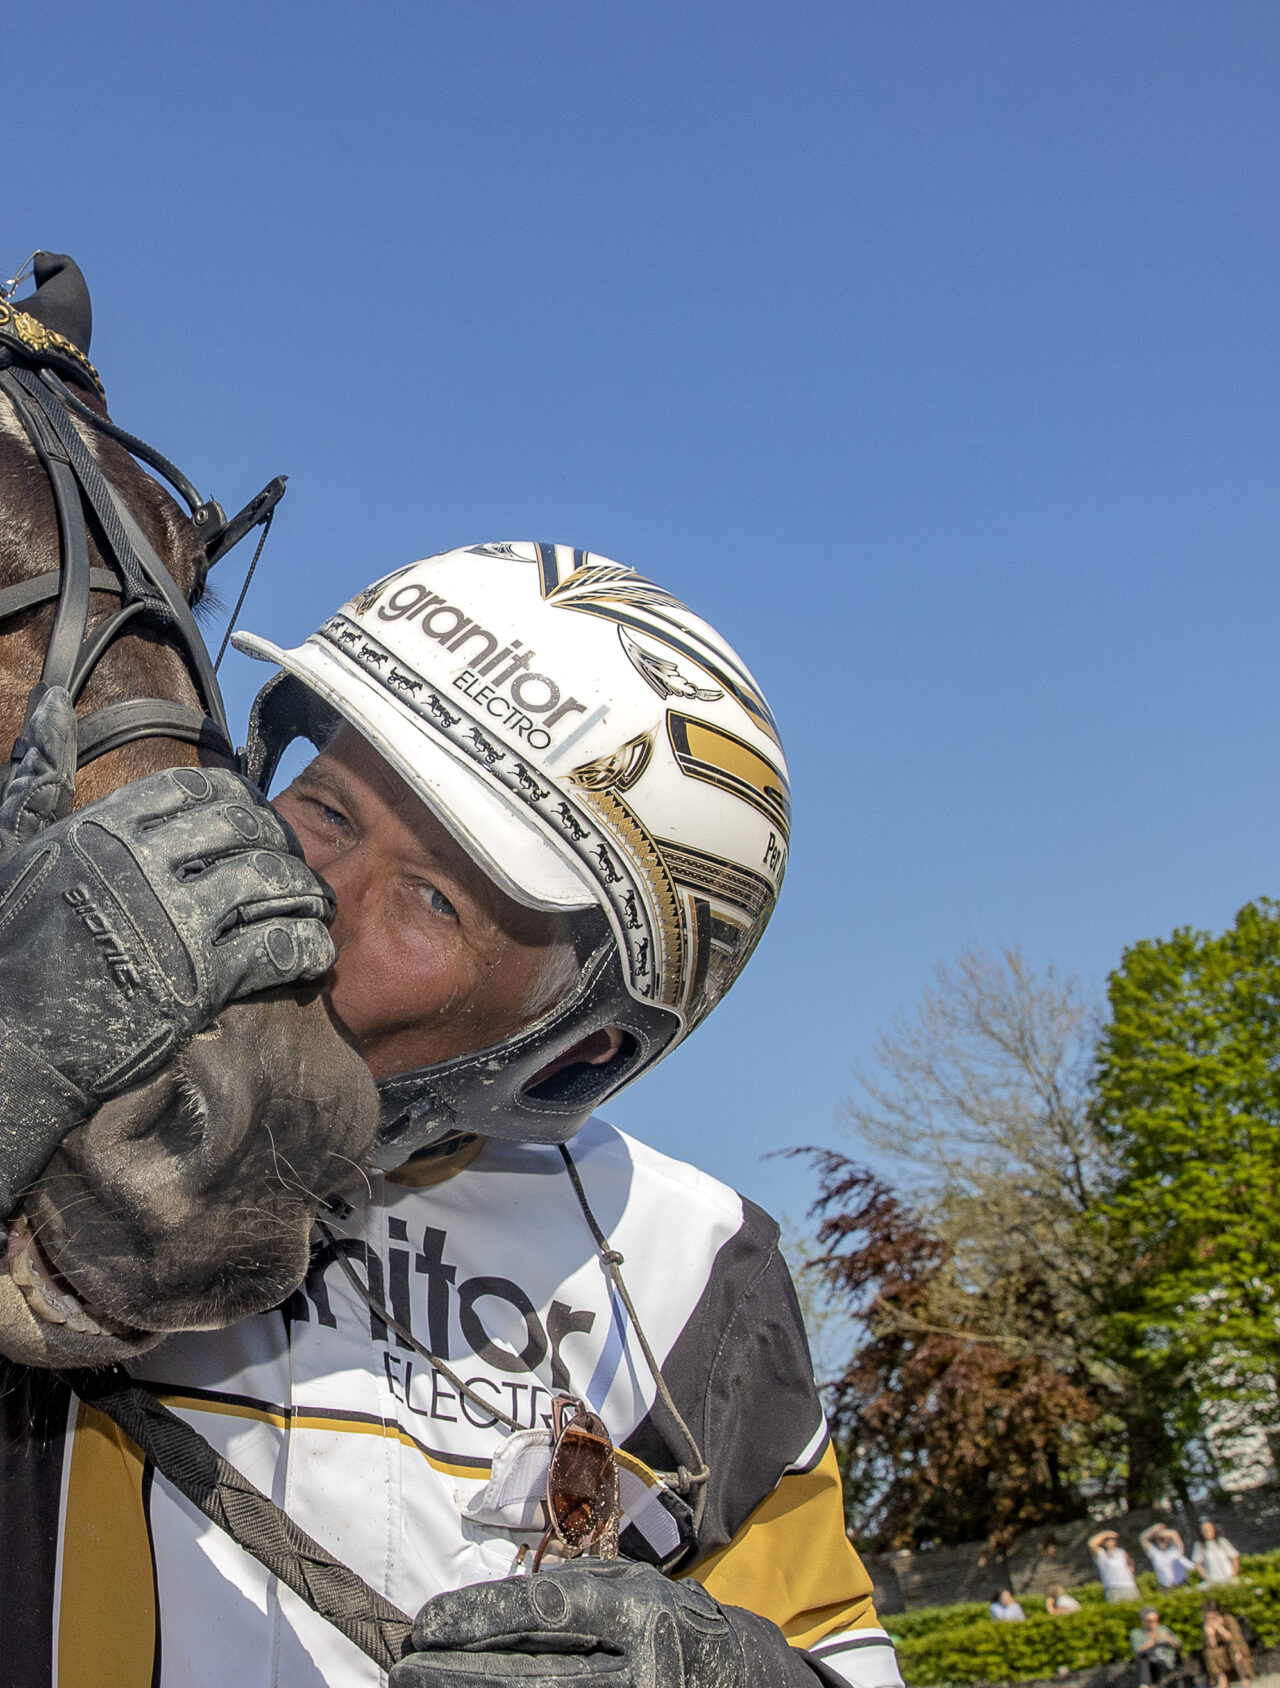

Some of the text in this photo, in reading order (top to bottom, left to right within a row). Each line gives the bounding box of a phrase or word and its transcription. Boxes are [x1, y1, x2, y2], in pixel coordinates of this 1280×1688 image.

[377, 583, 588, 729] granitor
[451, 670, 552, 750] ELECTRO
[288, 1215, 596, 1394] nitor
[383, 1351, 568, 1432] ELECTR
